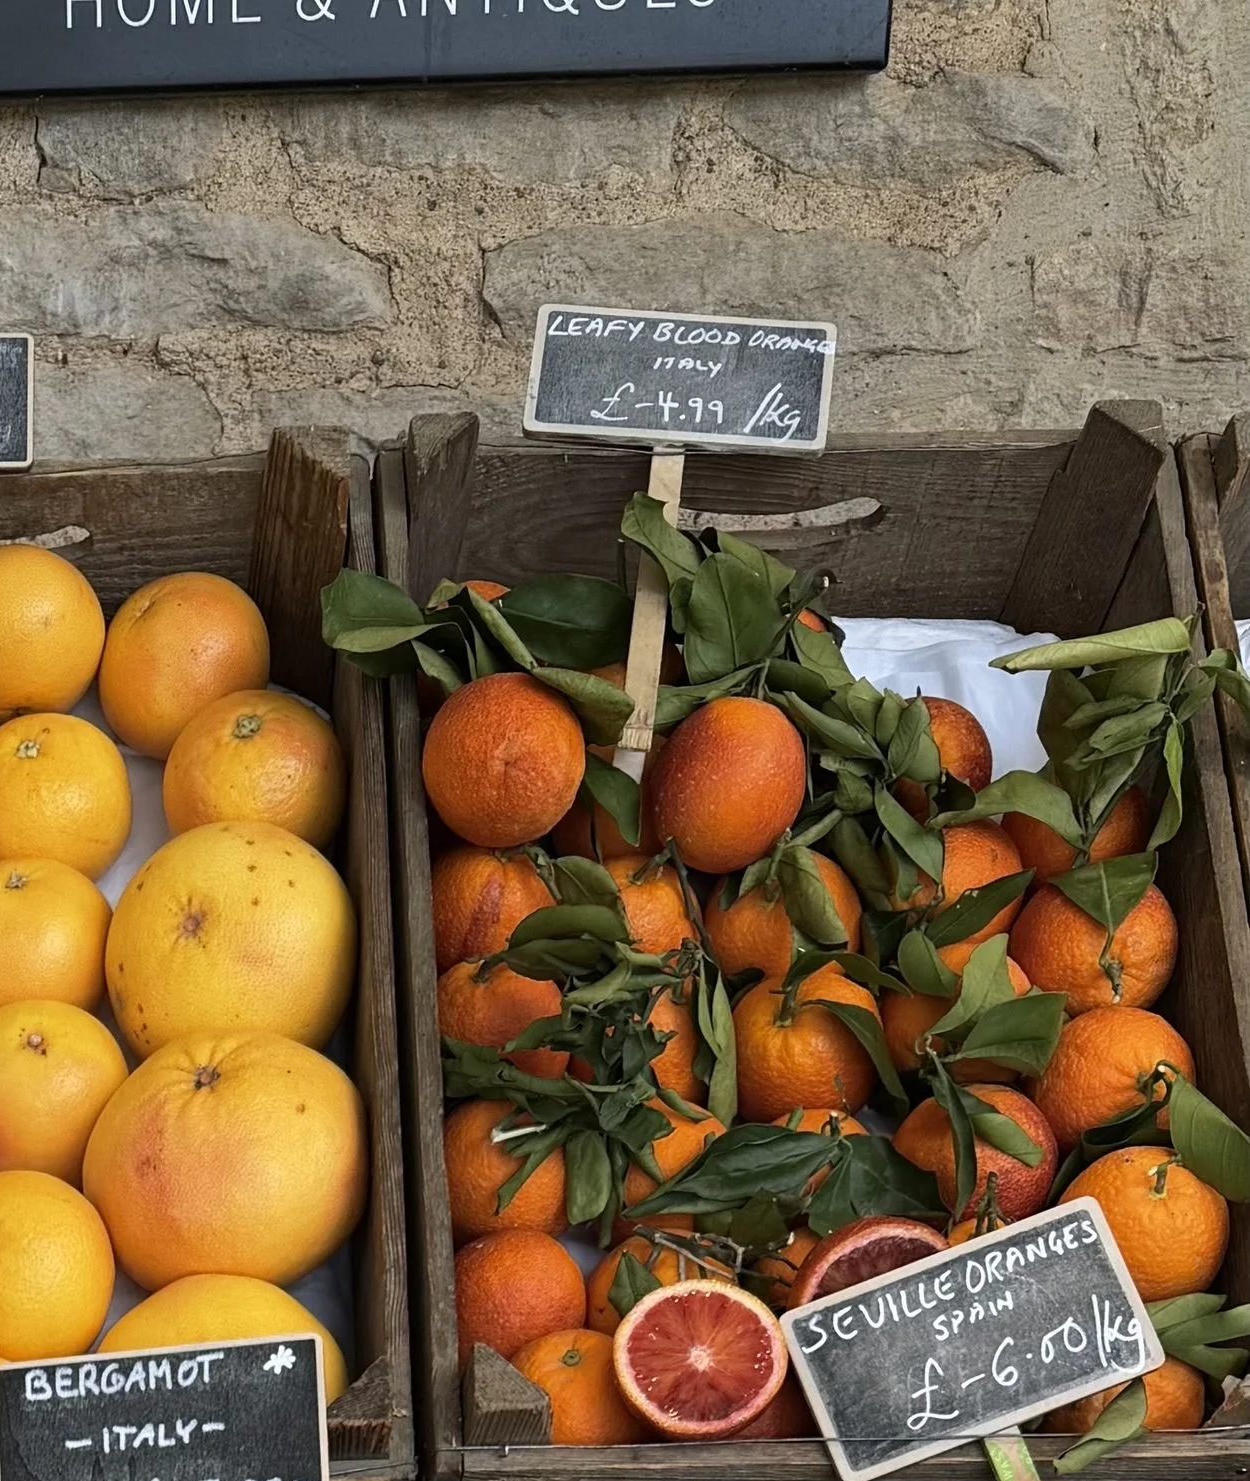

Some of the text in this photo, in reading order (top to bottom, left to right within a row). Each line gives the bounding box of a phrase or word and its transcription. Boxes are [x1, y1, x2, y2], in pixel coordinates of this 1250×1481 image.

[548, 315, 645, 342] LEAFY
[653, 321, 741, 346] BLOOD
[653, 357, 723, 378] ITALY
[801, 1219, 1099, 1355] SEVILLE ORANGES
[932, 1291, 1015, 1341] SPAIN
[24, 1351, 225, 1401] BERGAMOT
